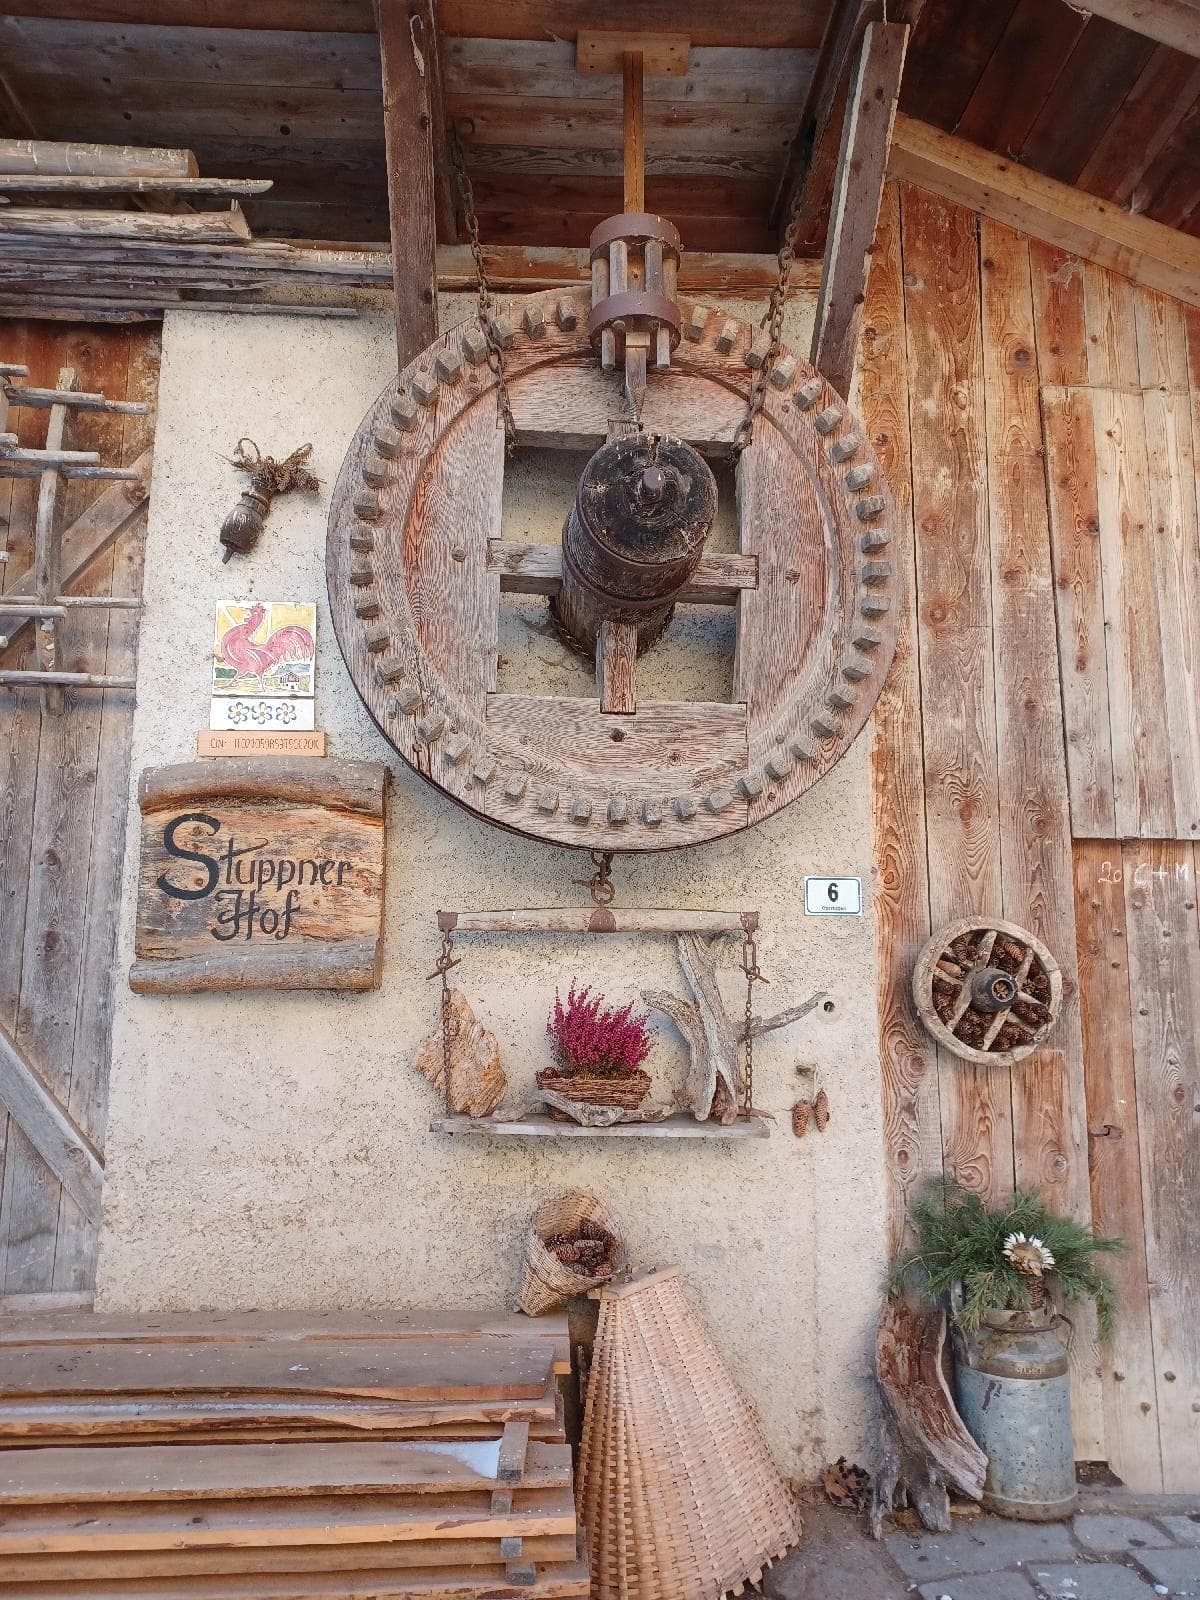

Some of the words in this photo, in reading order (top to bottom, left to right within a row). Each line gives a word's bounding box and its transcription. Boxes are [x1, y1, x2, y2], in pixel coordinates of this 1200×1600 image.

[155, 812, 352, 901] Stuppner
[210, 889, 301, 942] Hof
[827, 882, 839, 903] 6
